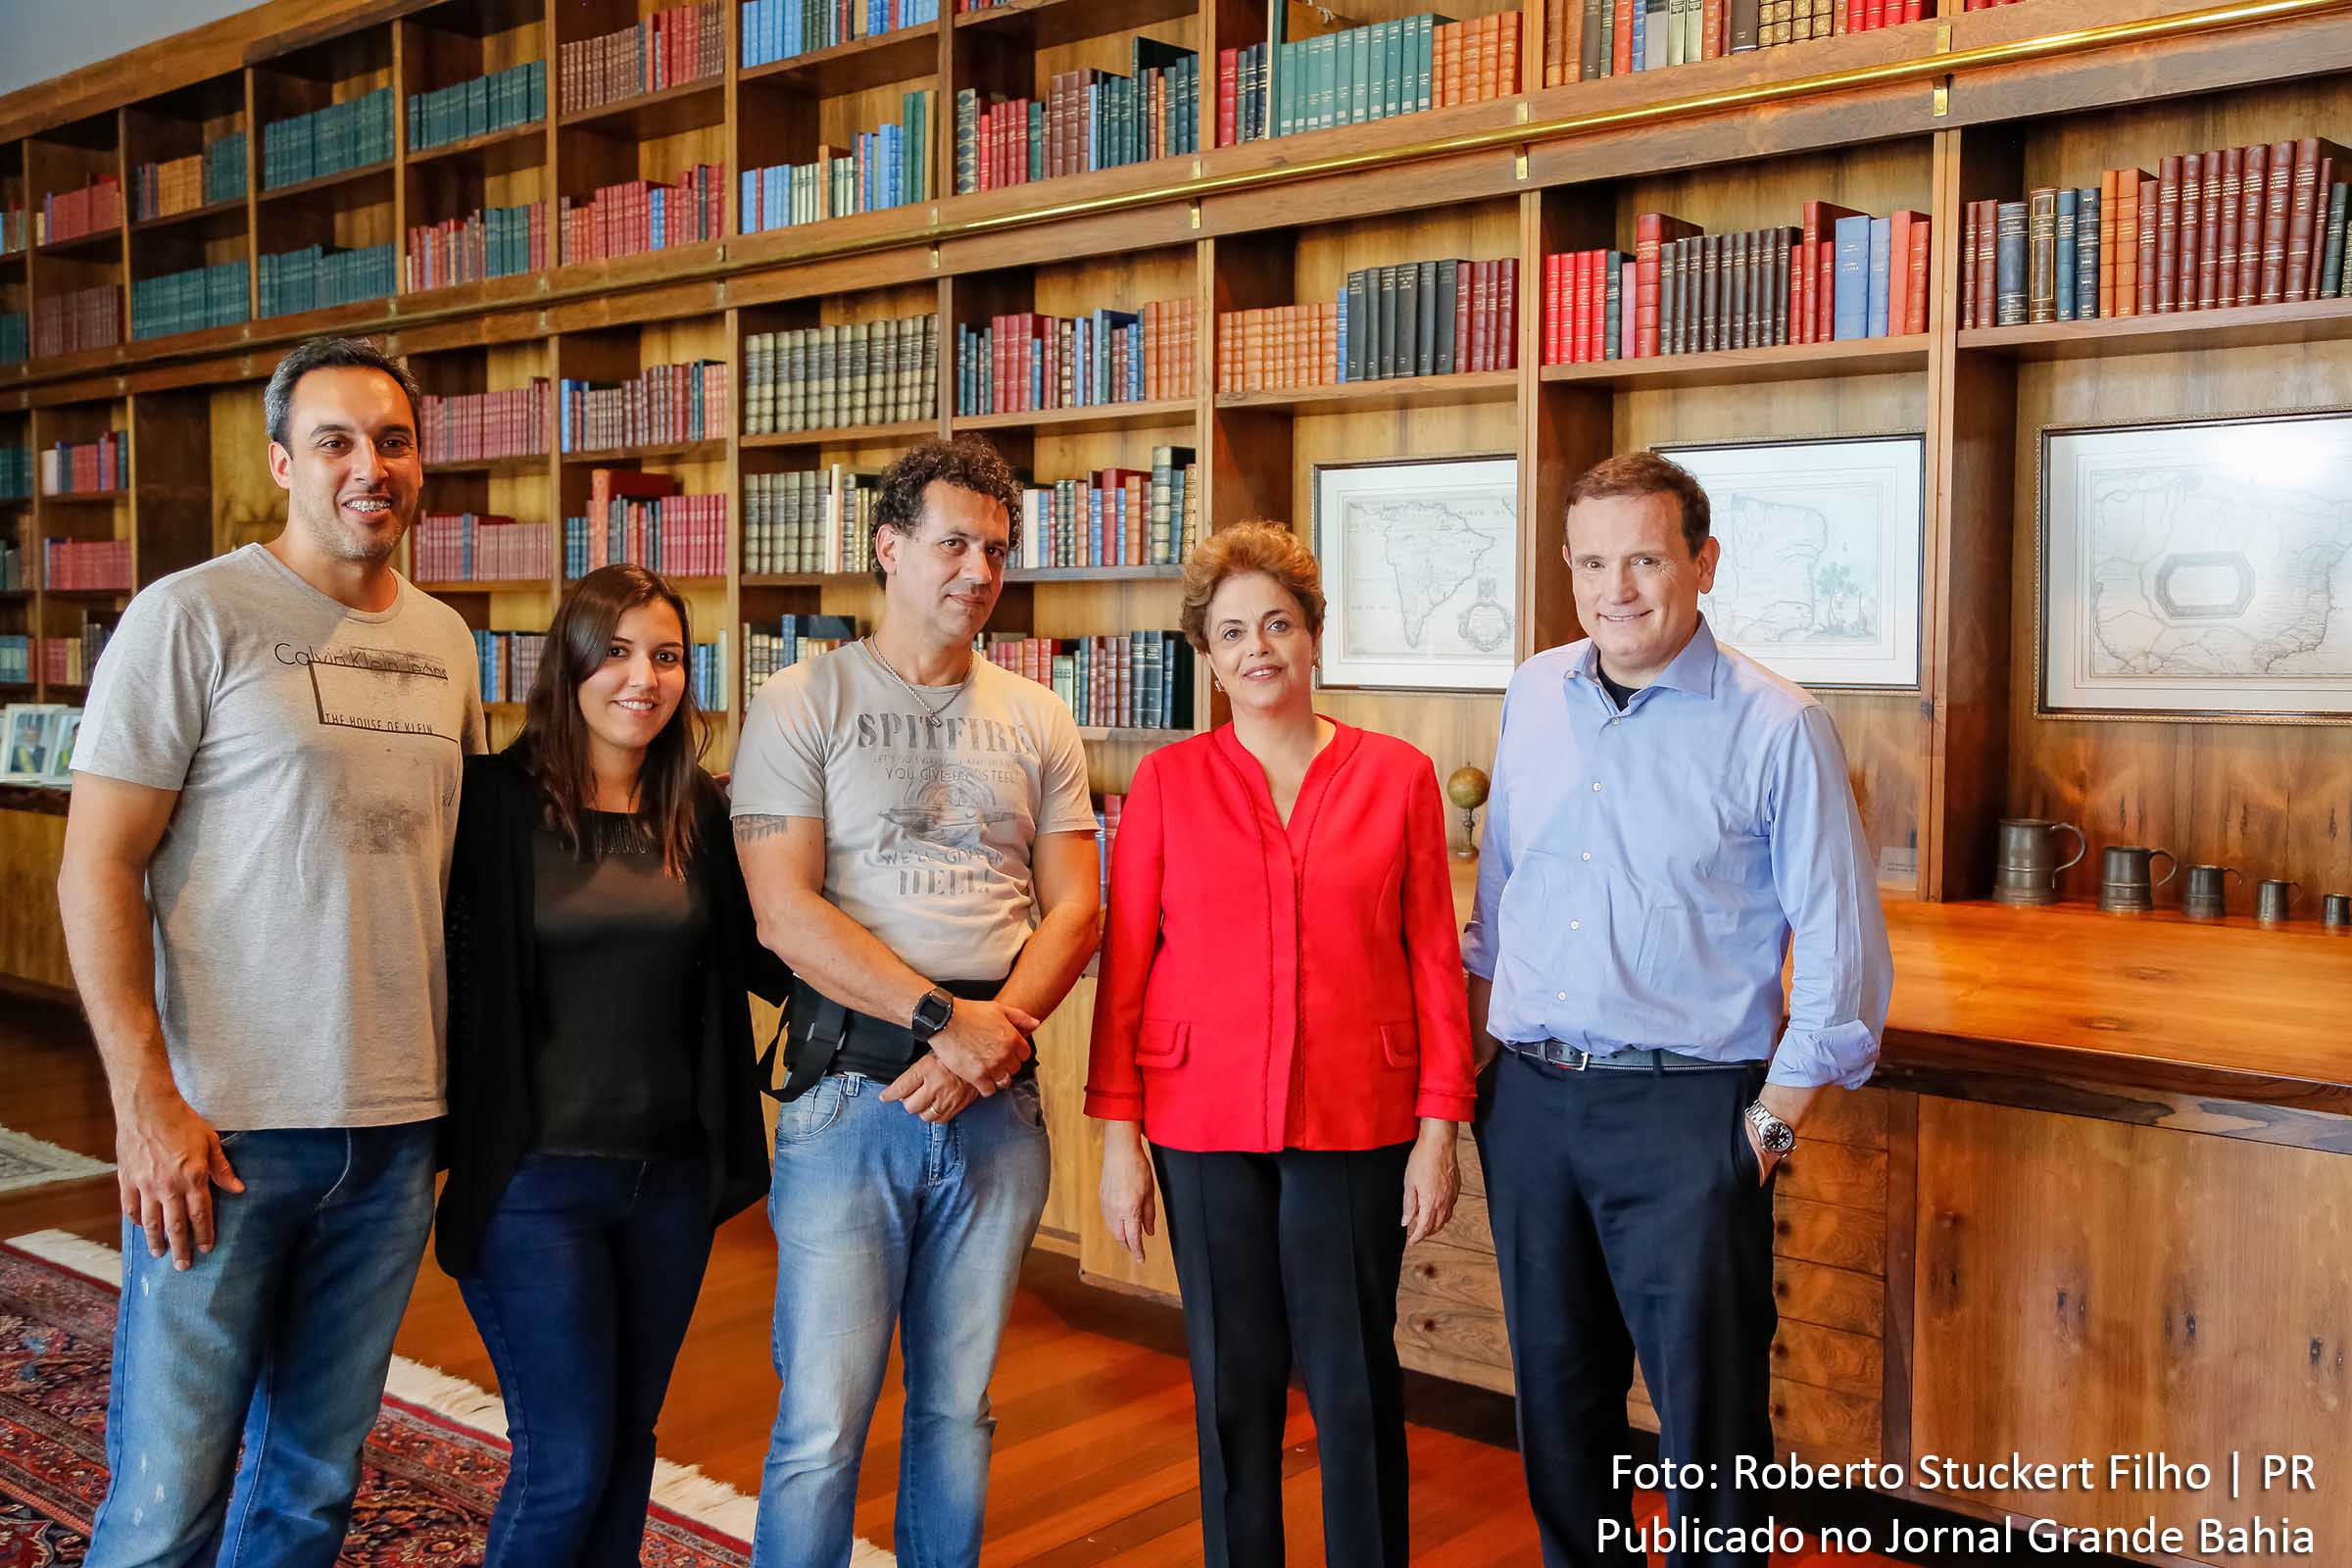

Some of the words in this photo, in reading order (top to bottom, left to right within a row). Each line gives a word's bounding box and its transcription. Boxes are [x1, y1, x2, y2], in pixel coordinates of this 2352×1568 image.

[274, 643, 345, 667] Calvin
[349, 650, 398, 671] Klein
[325, 712, 345, 725] THE
[349, 715, 382, 730] HOUSE
[405, 722, 433, 734] KLEIN
[886, 767, 914, 781] YOU
[920, 767, 948, 783] GIVE
